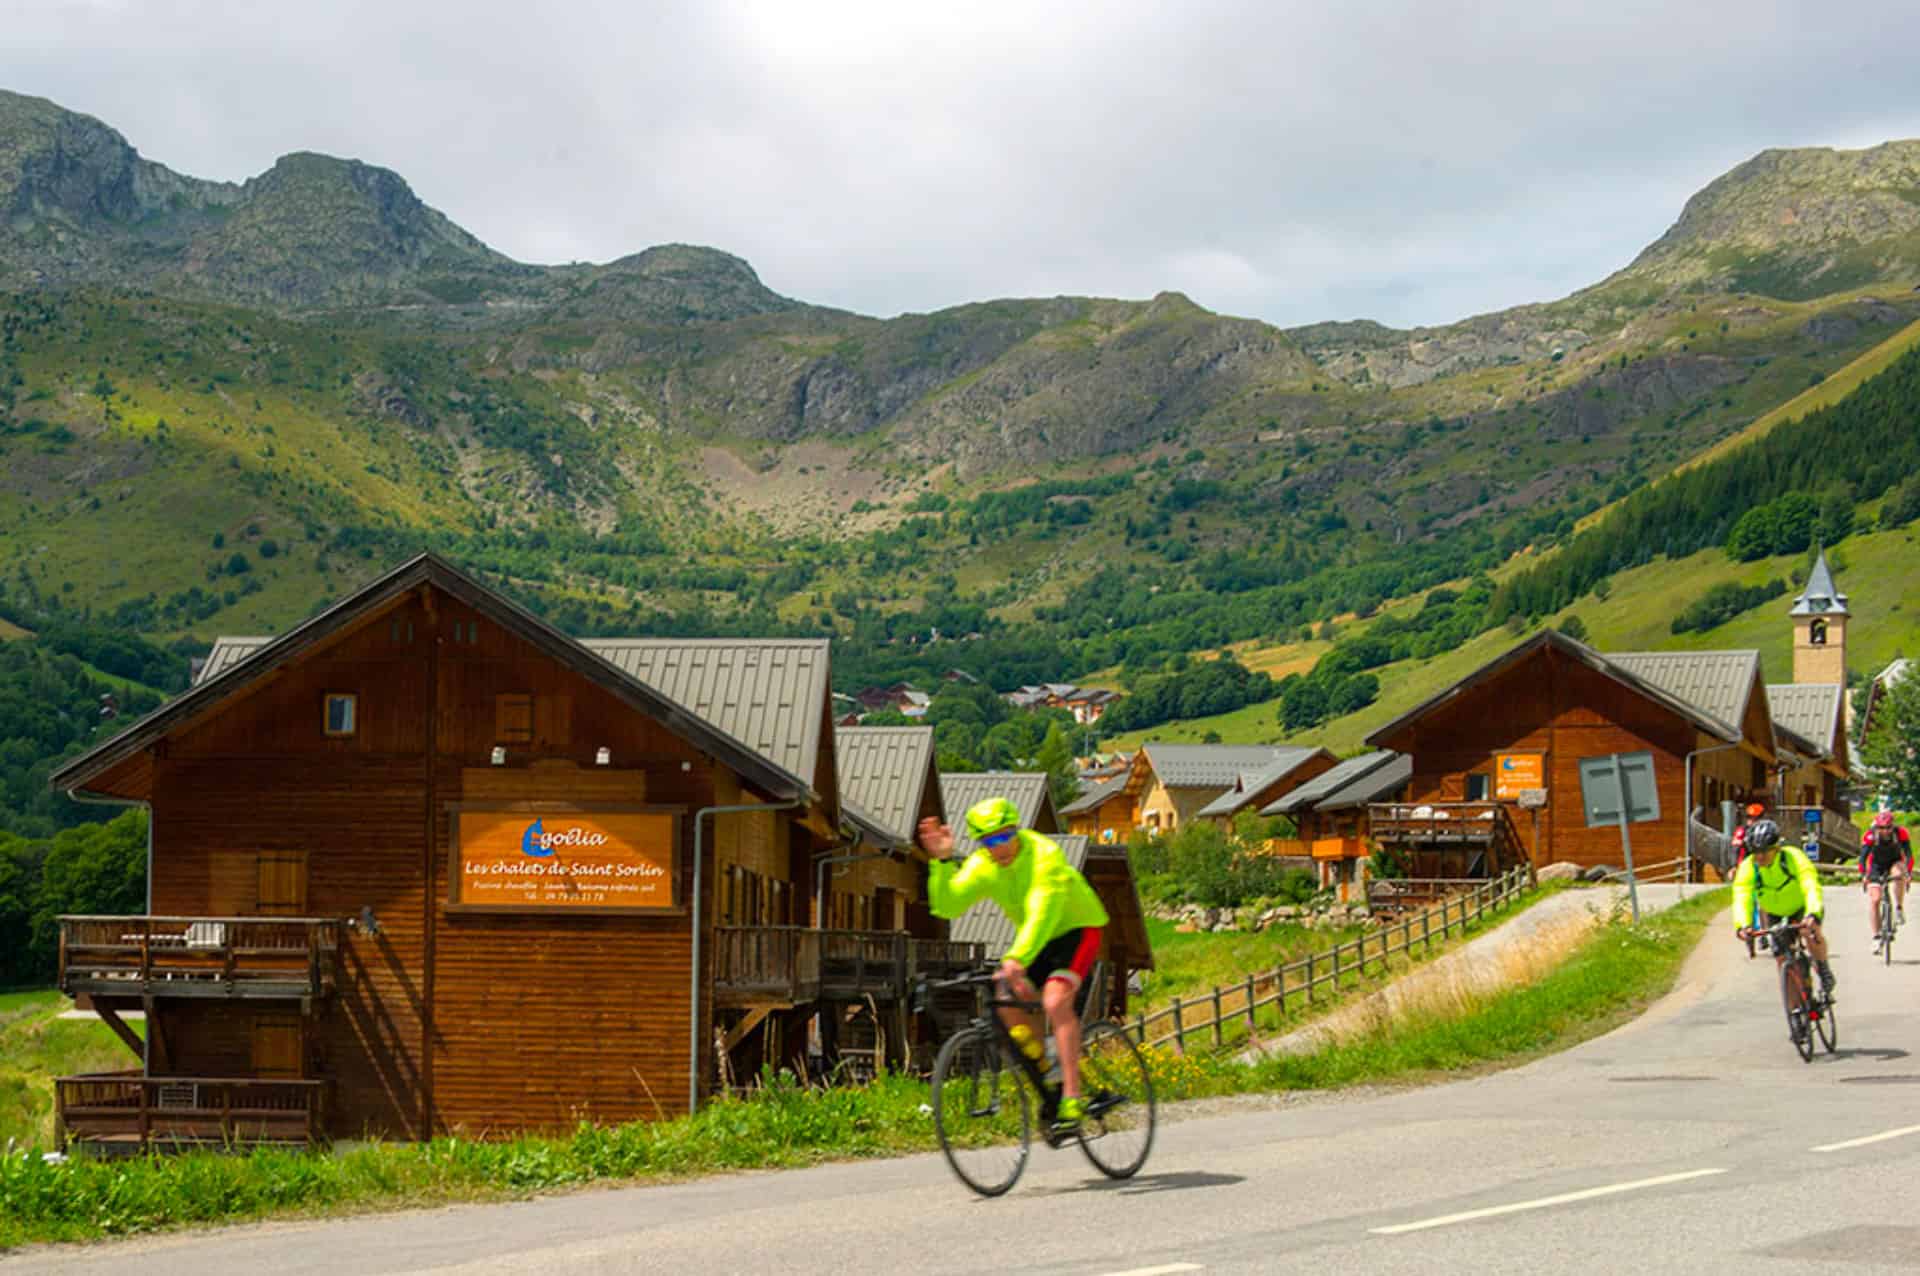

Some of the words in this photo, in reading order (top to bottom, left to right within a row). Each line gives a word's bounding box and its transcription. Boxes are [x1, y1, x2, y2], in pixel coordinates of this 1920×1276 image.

[465, 860, 488, 875] Les
[491, 859, 546, 876] chalets
[547, 860, 569, 875] de
[569, 861, 613, 877] Saint
[615, 863, 665, 877] Sorlin
